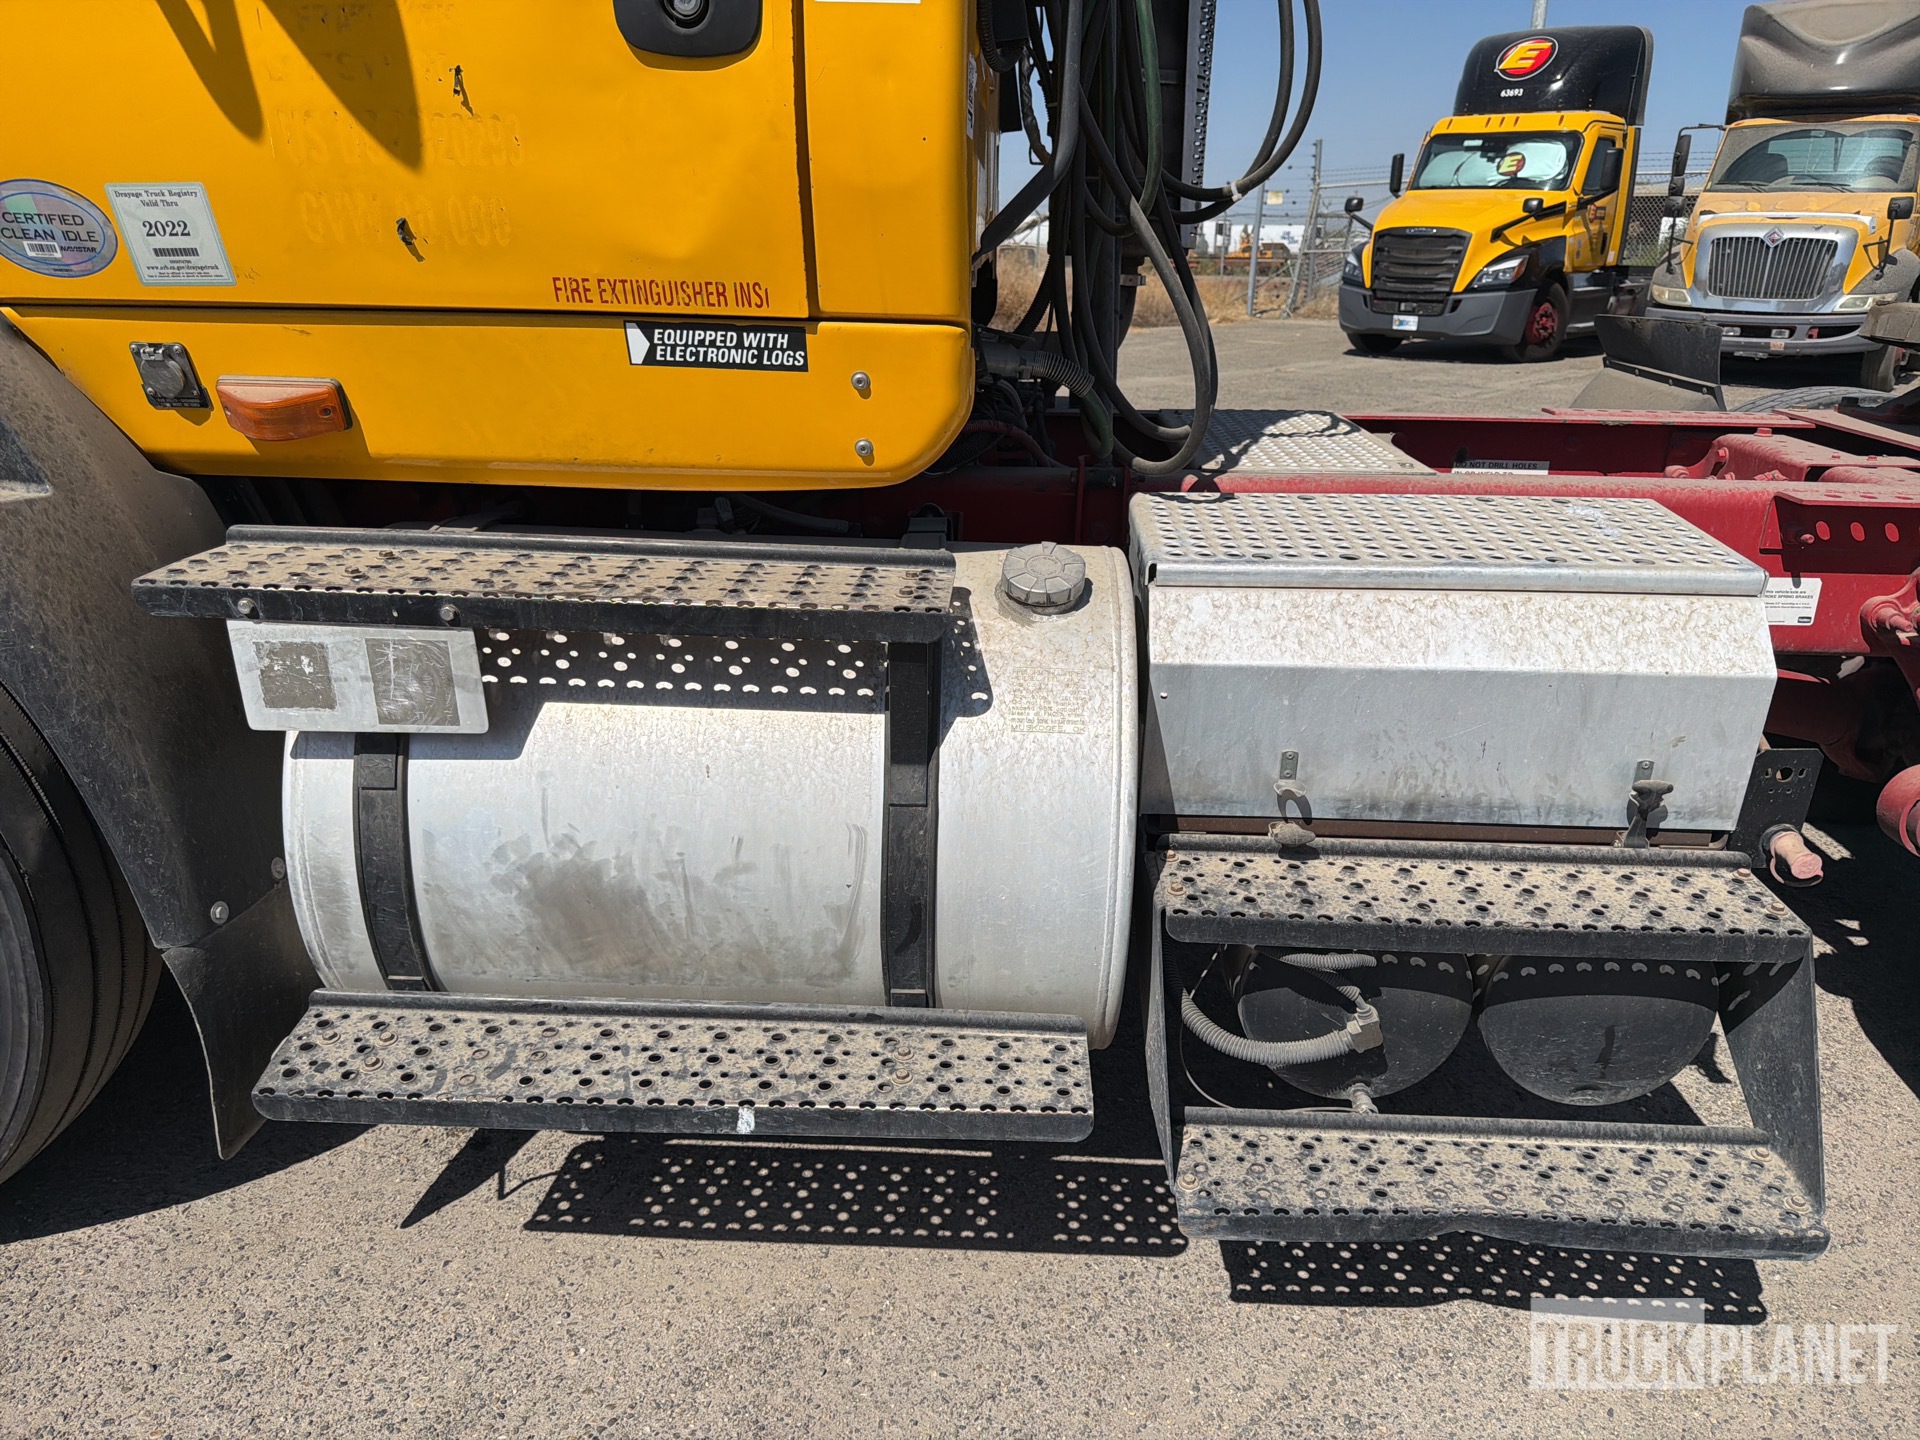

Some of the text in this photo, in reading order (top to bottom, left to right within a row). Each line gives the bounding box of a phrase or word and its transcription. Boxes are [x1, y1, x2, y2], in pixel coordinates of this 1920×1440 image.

[1500, 88, 1524, 97] 63693
[114, 190, 143, 199] Drayage
[167, 189, 198, 198] Registry
[140, 199, 179, 207] Valid Thru
[2, 211, 85, 226] CERTIFIED
[1, 227, 99, 242] CLEAN IDLE
[142, 220, 191, 237] 2022
[60, 245, 97, 253] NAVISTAR
[552, 276, 594, 304] FIRE
[596, 278, 728, 308] EXTINGUISHER
[653, 328, 789, 349] EQUIPPED WITH
[656, 345, 805, 366] ELECTRONIC LOGS
